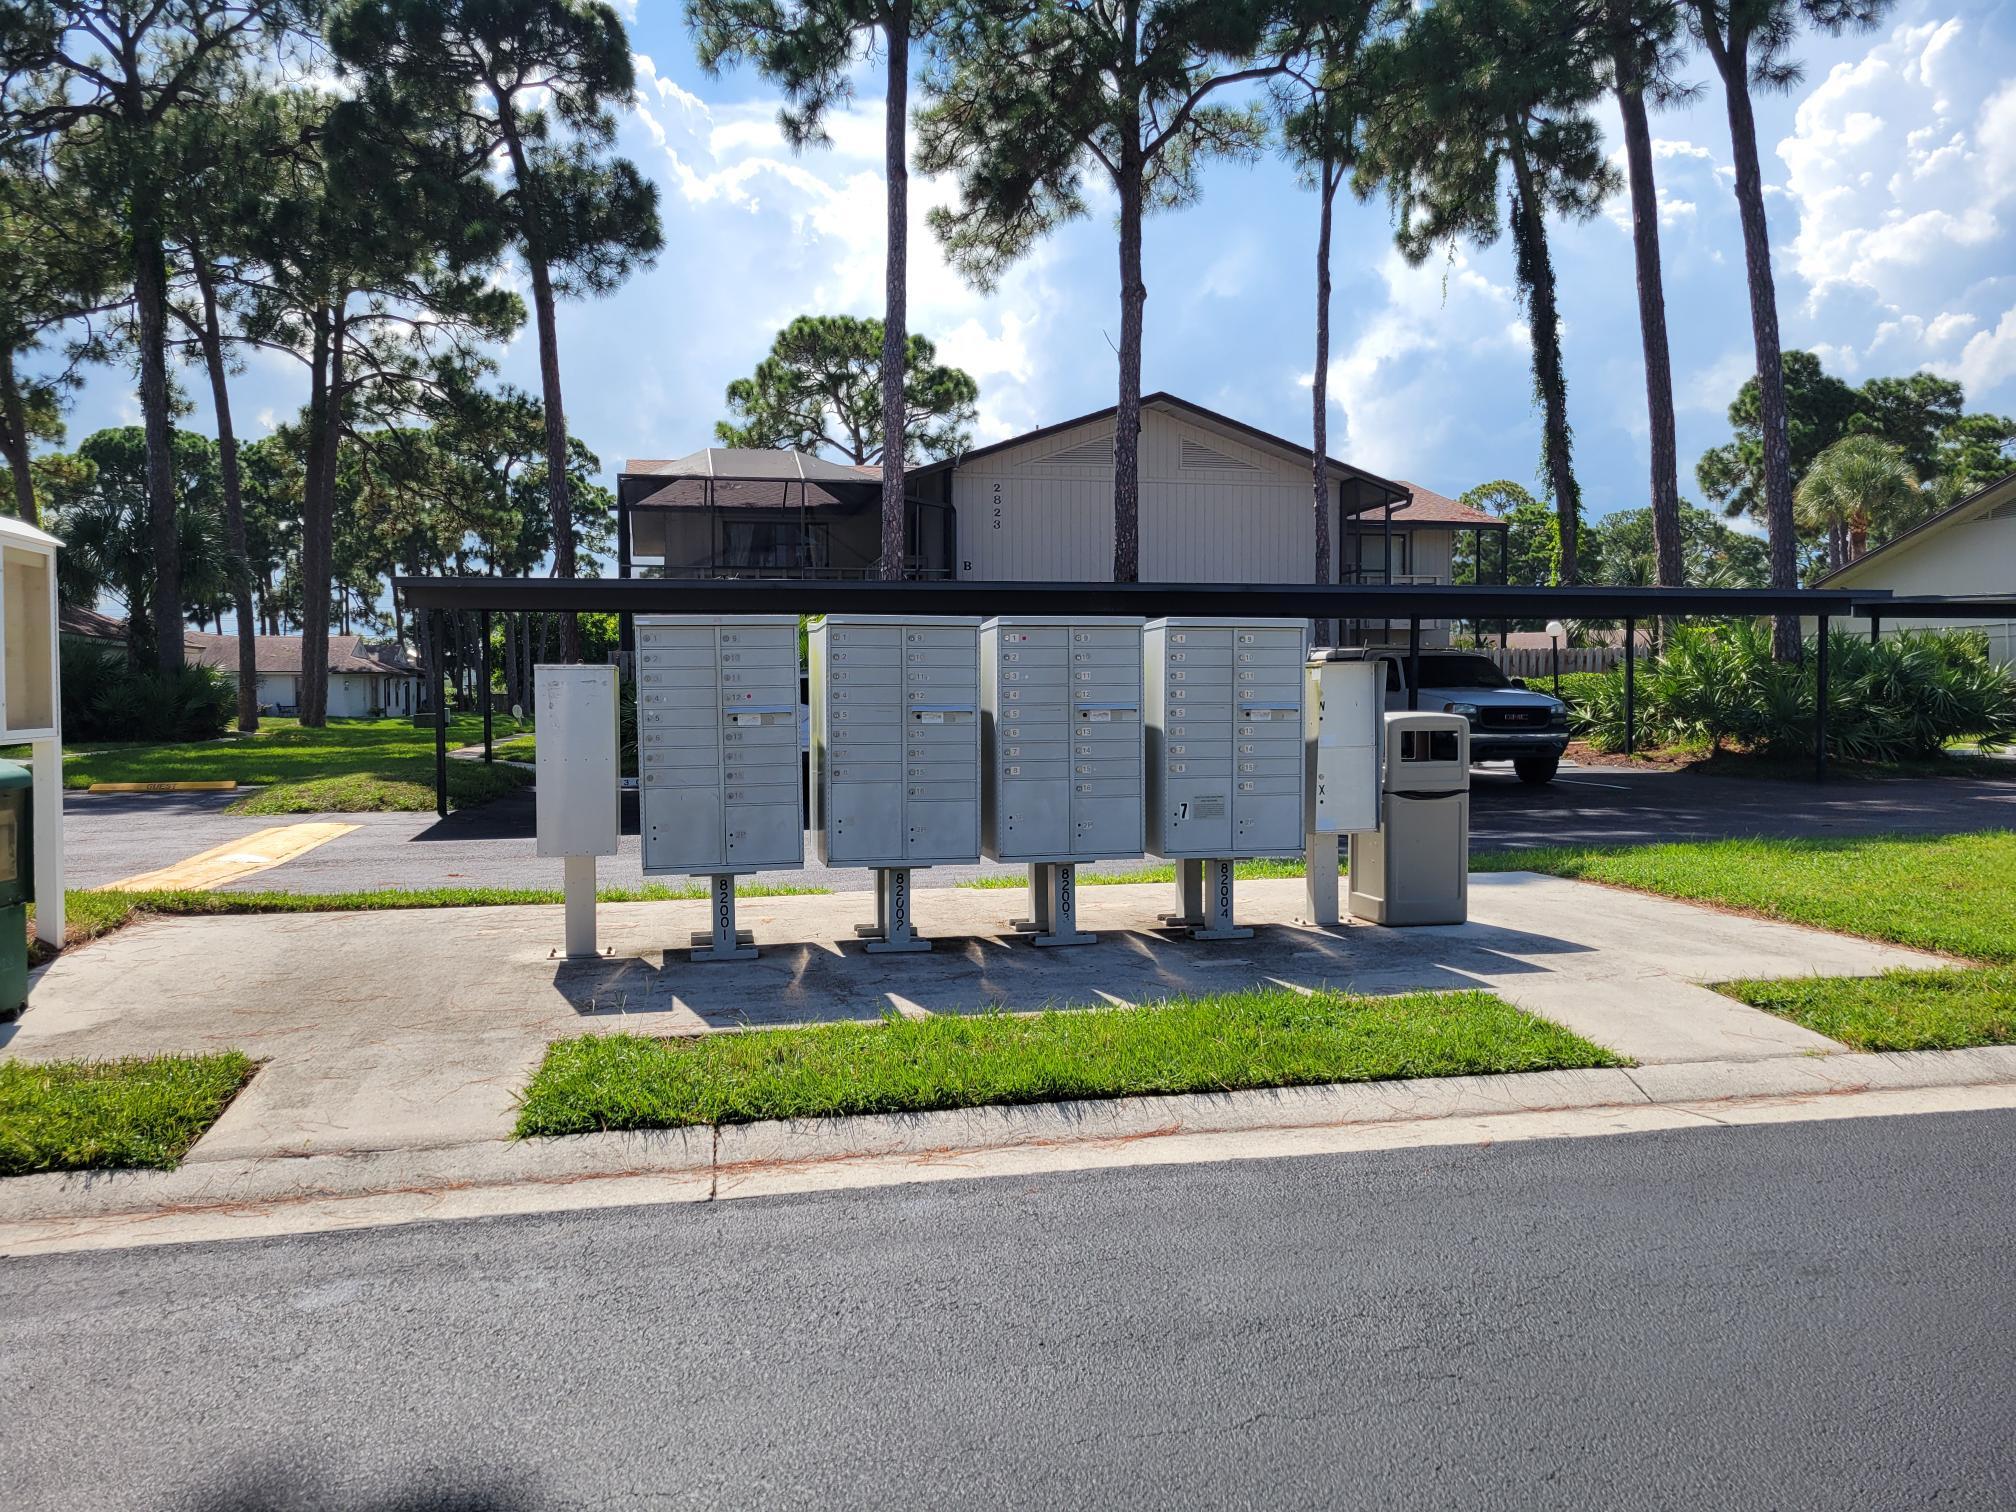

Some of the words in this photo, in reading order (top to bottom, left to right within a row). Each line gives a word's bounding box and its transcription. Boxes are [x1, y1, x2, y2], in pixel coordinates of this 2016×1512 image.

[963, 562, 972, 571] B
[1320, 701, 1325, 711] N
[1319, 785, 1325, 795] X
[1180, 803, 1188, 819] 7
[720, 879, 729, 940] 82001
